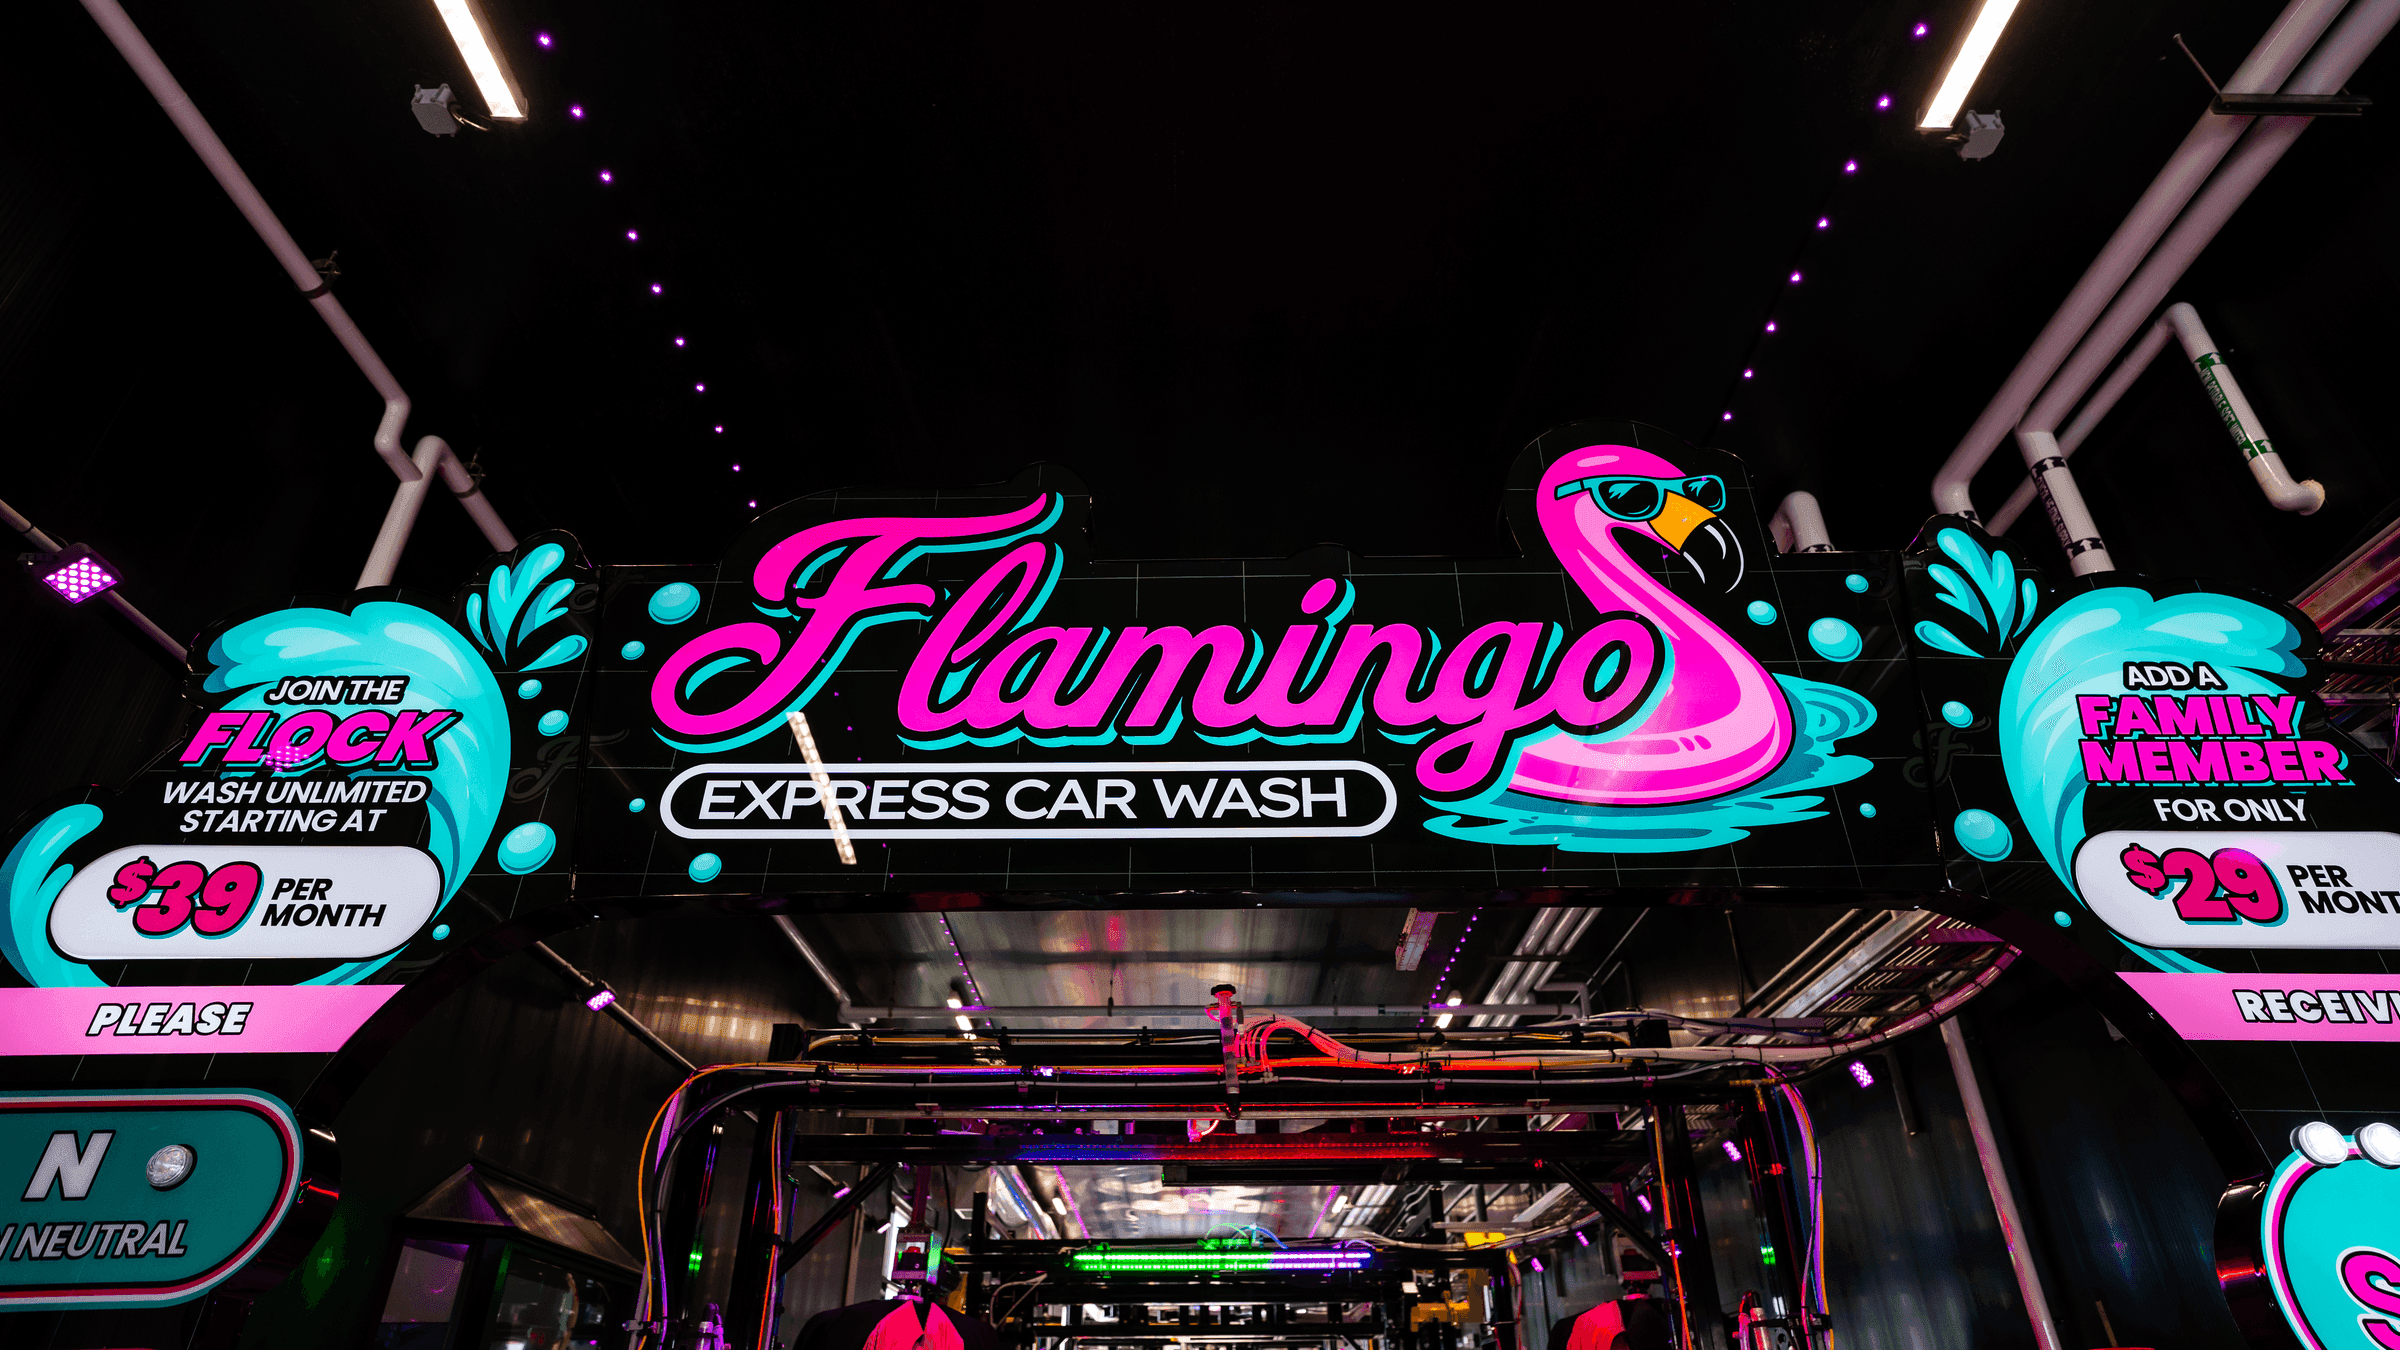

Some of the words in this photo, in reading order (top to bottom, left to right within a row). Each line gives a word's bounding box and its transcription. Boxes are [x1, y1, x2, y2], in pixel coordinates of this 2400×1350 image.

[651, 492, 1660, 795] Flamingo
[268, 680, 346, 702] JOIN
[350, 679, 406, 701] THE
[2127, 665, 2191, 687] ADD
[2197, 664, 2222, 687] A
[2077, 694, 2298, 736] FAMILY
[178, 709, 454, 764] FLOCK
[2079, 739, 2347, 783] MEMBER
[162, 781, 261, 804] WASH
[265, 780, 428, 803] UNLIMITED
[698, 778, 991, 821] EXPRESS
[1005, 777, 1137, 821] CAR
[1152, 776, 1348, 820] WASH
[179, 809, 338, 832] STARTING
[339, 808, 388, 832] AT
[2153, 798, 2222, 822] FOR
[2223, 798, 2307, 822] ONLY
[271, 878, 333, 901] PER
[2120, 842, 2284, 924] $29
[2286, 864, 2353, 888] PER
[107, 856, 264, 937] $39
[260, 903, 387, 927] MONTH
[87, 1002, 254, 1036] PLEASE
[2232, 990, 2400, 1023] RECEIV
[22, 1130, 115, 1201] N
[11, 1221, 187, 1260] NEUTRAL
